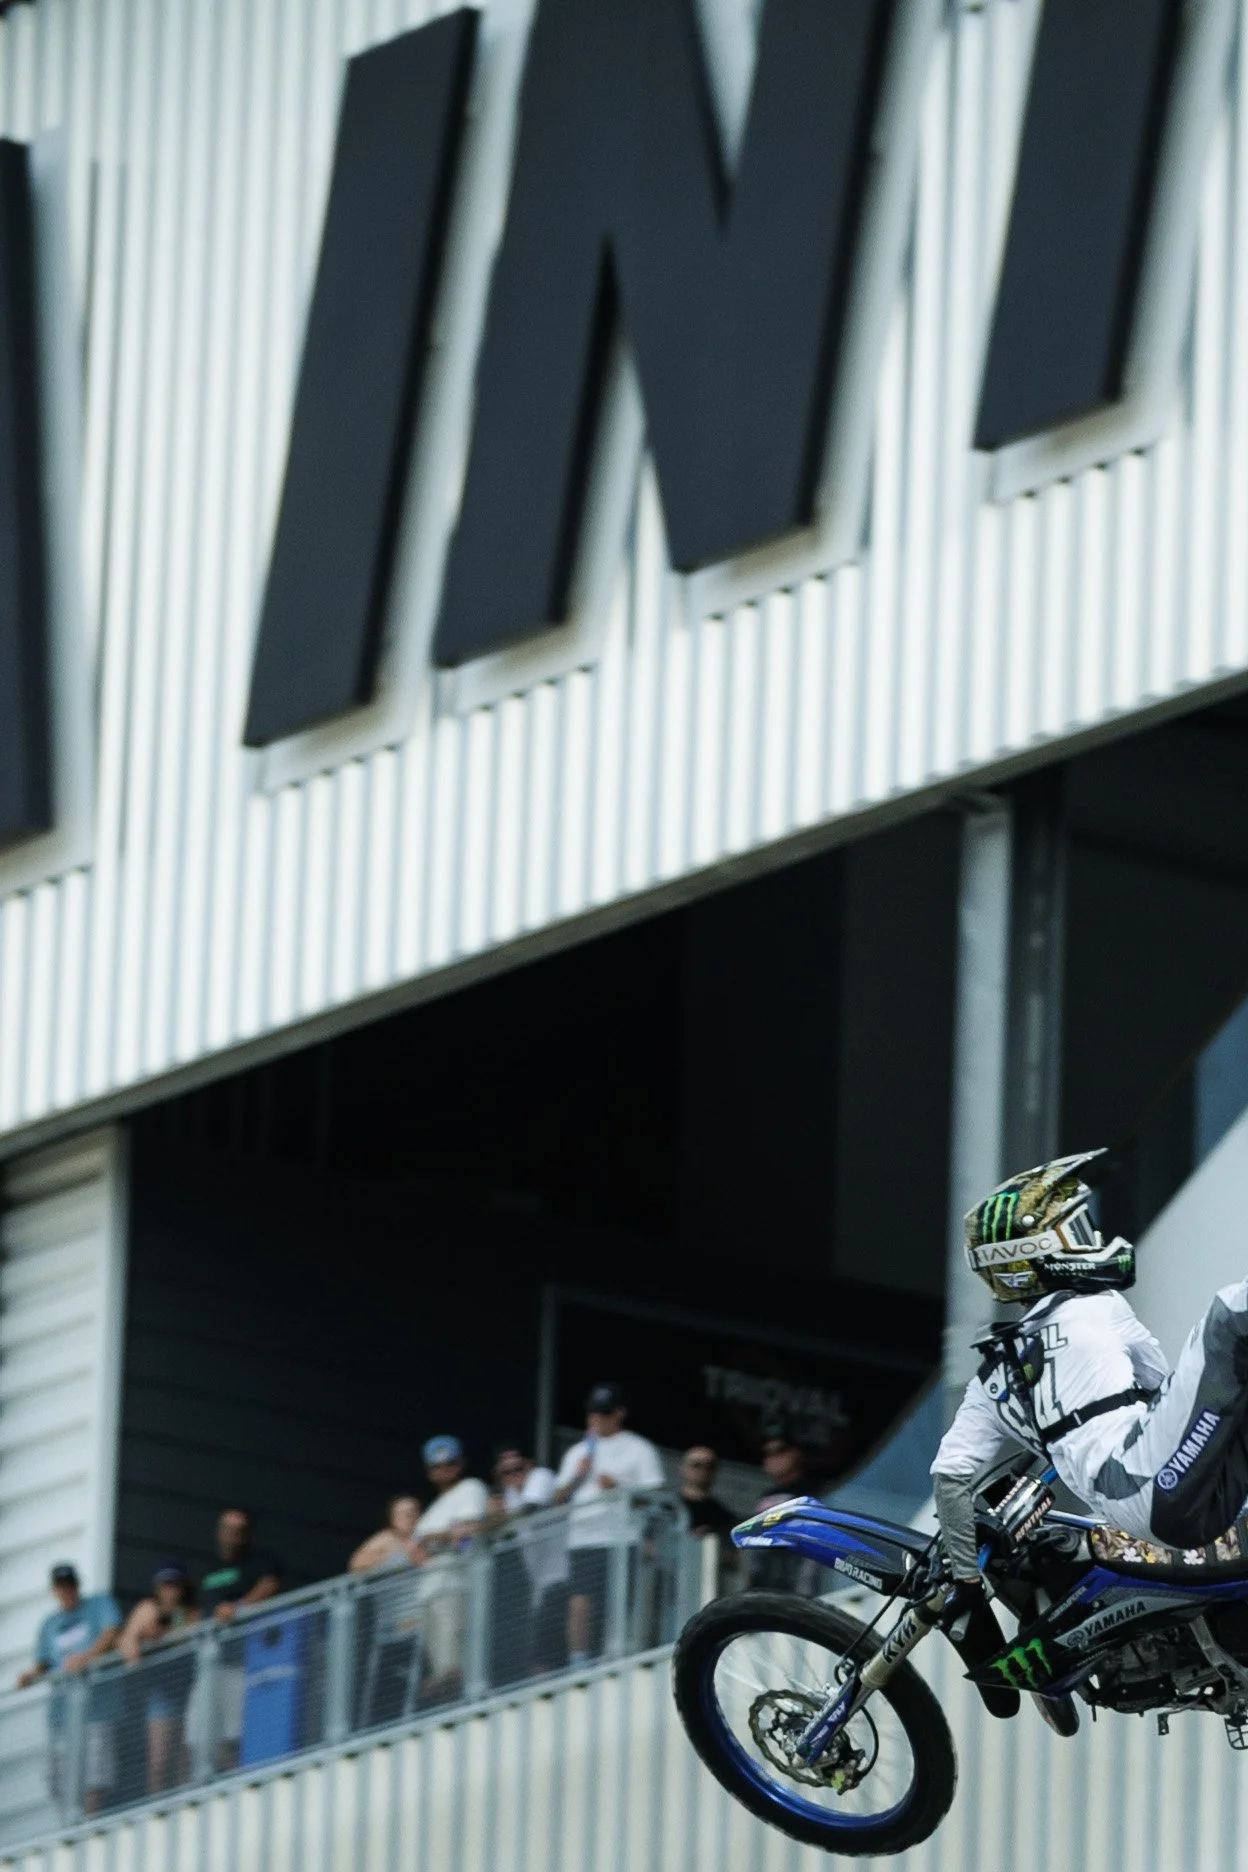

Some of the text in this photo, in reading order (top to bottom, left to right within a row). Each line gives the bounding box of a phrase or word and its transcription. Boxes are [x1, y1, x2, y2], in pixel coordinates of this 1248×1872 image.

[1044, 1261, 1096, 1271] MONSTER
[1169, 1411, 1220, 1473] YAMAHA
[1084, 1601, 1147, 1637] YAMAHA
